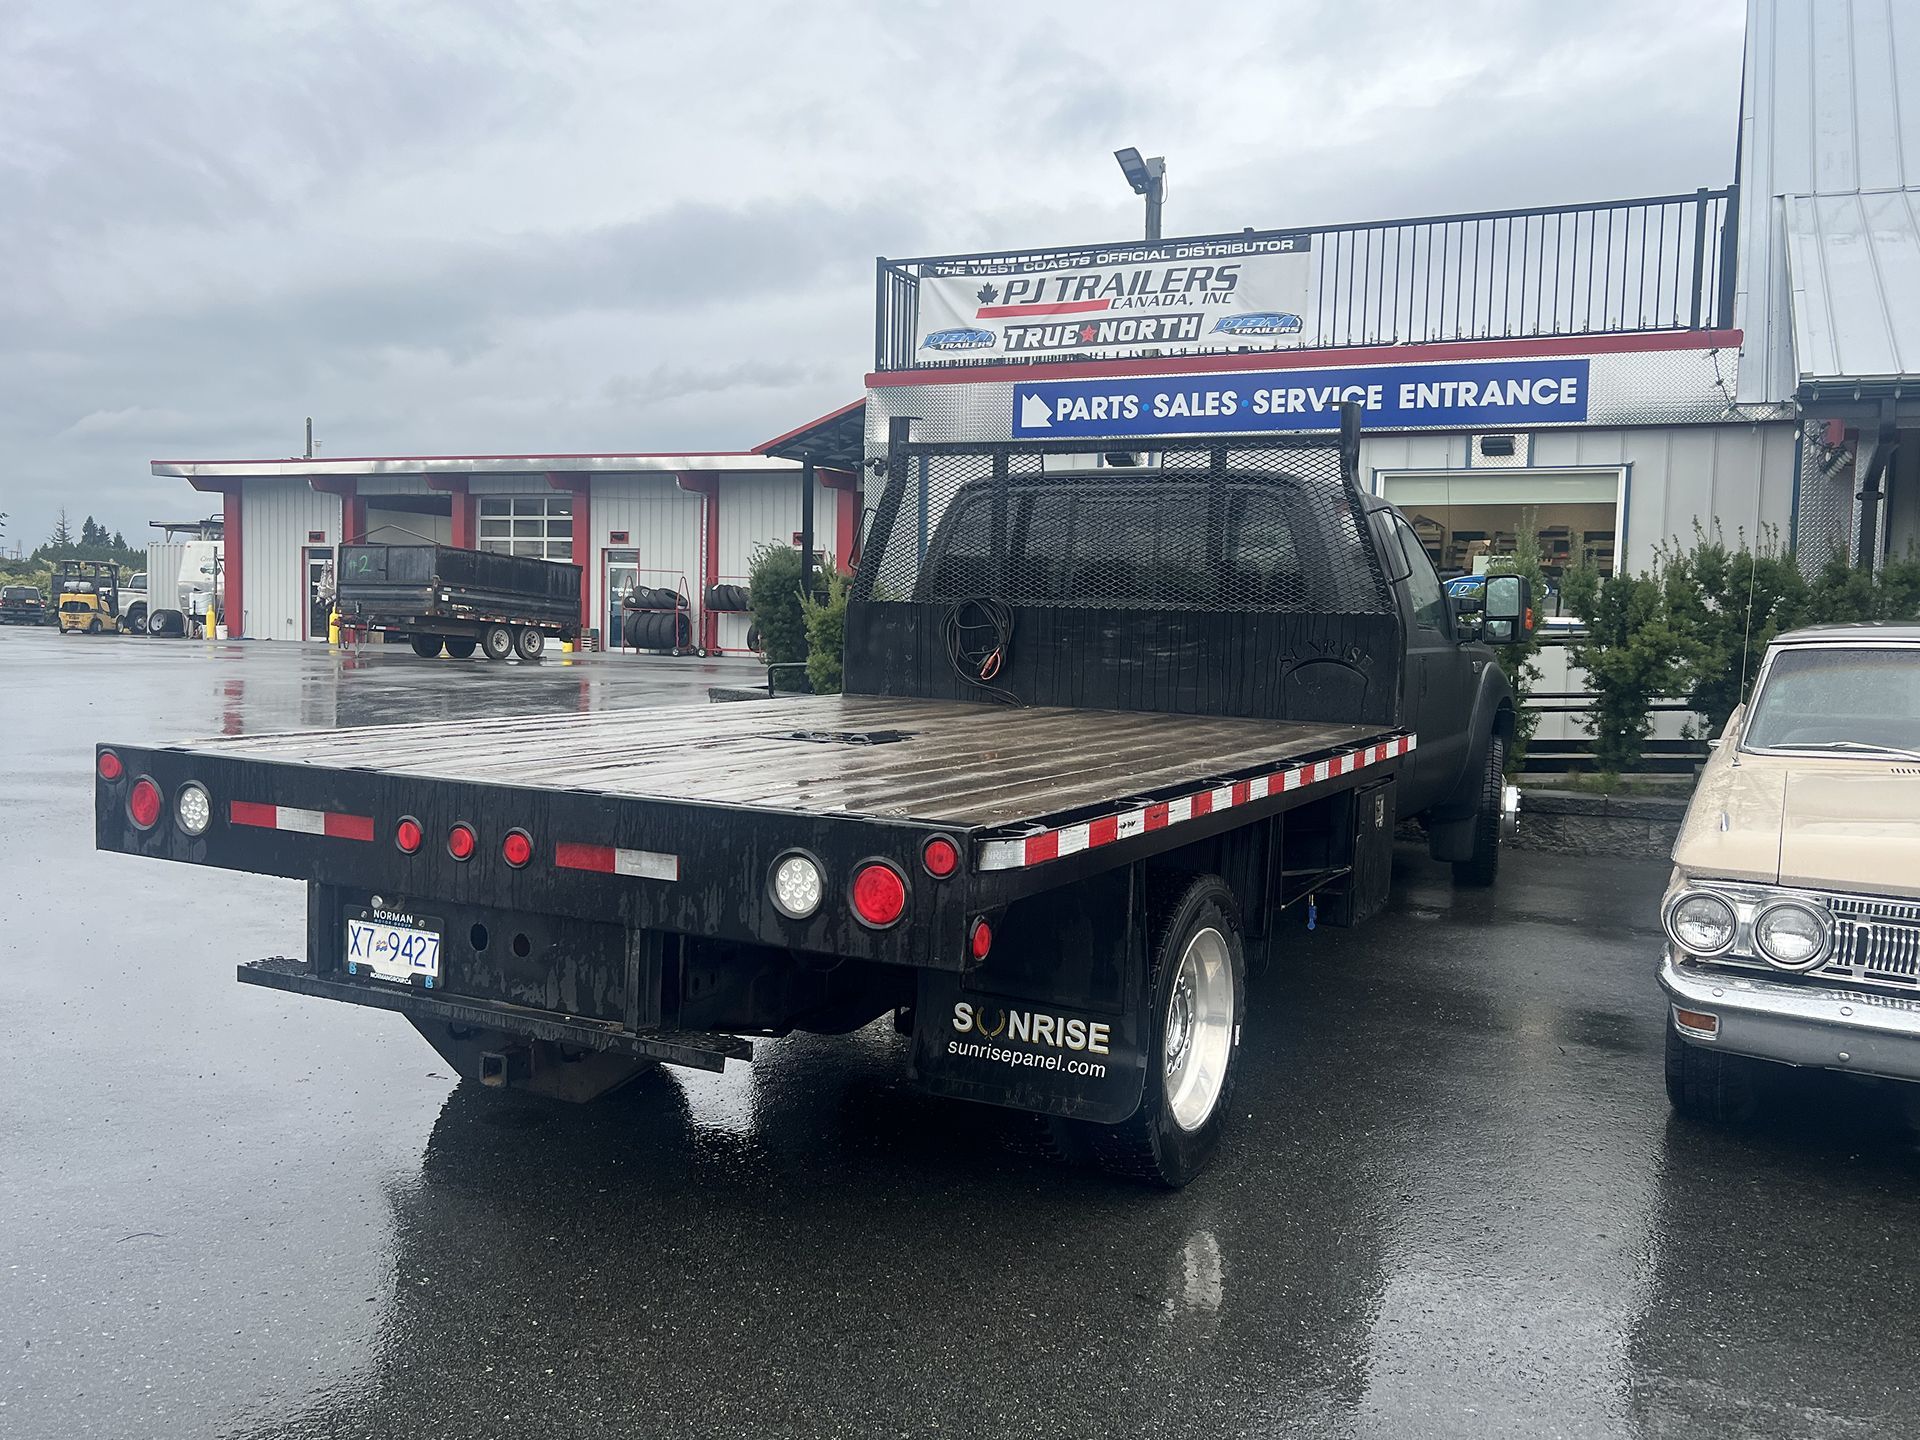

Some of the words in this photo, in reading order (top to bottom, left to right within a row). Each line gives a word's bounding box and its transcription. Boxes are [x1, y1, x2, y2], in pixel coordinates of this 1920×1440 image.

[935, 266, 966, 275] THE
[972, 263, 1018, 275] WEST
[1022, 256, 1091, 272] COASTS
[1096, 249, 1171, 264] OFFICIAL
[1175, 239, 1295, 258] DISTRIBUTOR
[1002, 278, 1047, 305] PJ
[1055, 264, 1242, 302] TRAILERS
[1201, 291, 1235, 304] INC
[1006, 323, 1081, 350] TRUE
[1096, 316, 1199, 343] NORTH
[1234, 326, 1300, 335] TRAILERS
[1056, 394, 1140, 422] PARTS
[1153, 390, 1238, 419] SALES
[1252, 384, 1383, 415] SERVICE
[1399, 377, 1578, 409] ENTRANCE
[373, 909, 413, 923] NORMAN
[388, 931, 440, 969] 9427
[952, 1002, 1111, 1055] SUNRISE
[947, 1040, 1106, 1079] sunrisepanel.com
